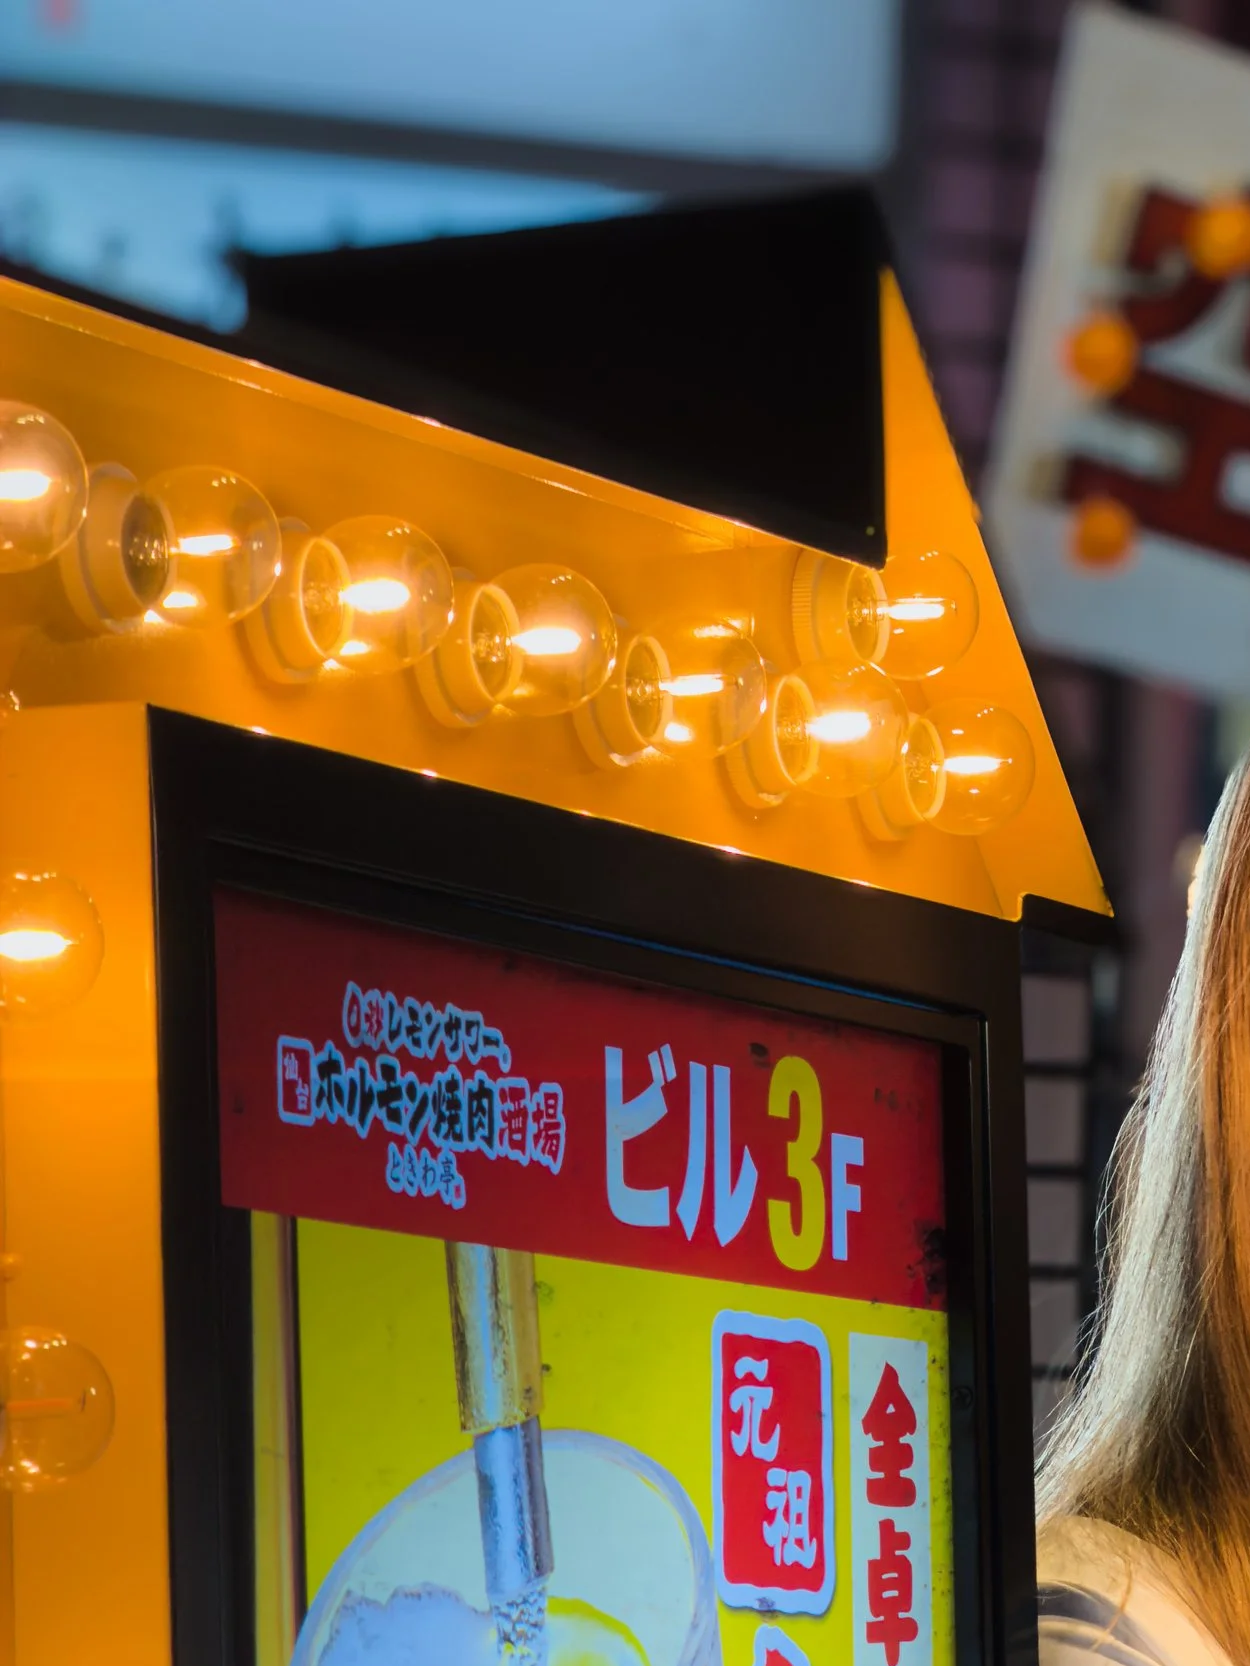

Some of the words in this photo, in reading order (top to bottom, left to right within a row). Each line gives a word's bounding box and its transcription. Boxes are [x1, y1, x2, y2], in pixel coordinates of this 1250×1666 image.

[389, 1147, 456, 1196] ときわ亭
[729, 1356, 817, 1570] 元祖
